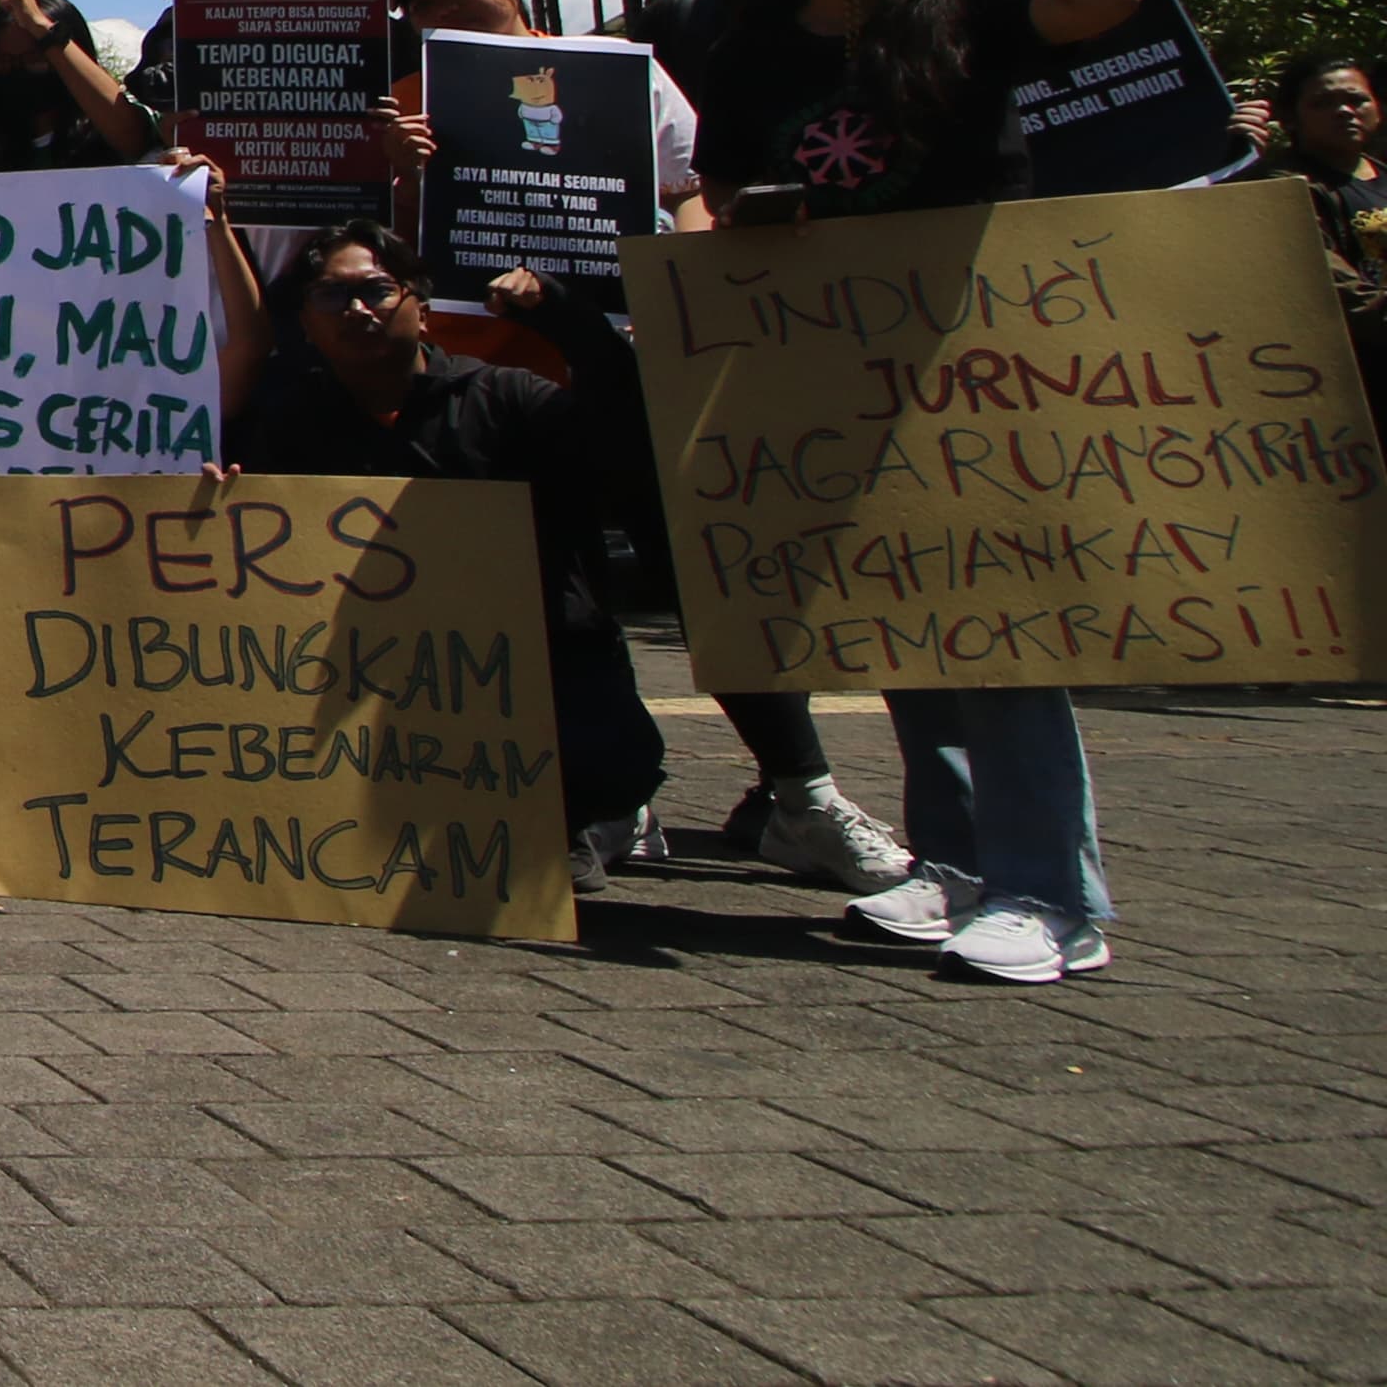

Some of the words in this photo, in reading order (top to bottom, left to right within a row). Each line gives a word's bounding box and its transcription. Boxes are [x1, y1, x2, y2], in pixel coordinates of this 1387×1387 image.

[197, 44, 265, 64] TEMPO
[271, 44, 365, 66] DIGUGAT,
[221, 68, 344, 88] KEBENARAN
[1070, 39, 1181, 89] KEBEBASAN
[200, 91, 366, 112] DIPERTARUHKAN
[1047, 94, 1109, 128] GAGAL
[1108, 68, 1185, 109] DIMUAT
[453, 166, 487, 182] SAYA
[491, 169, 561, 187] HANYALAH
[564, 174, 625, 192] SEORANG
[561, 195, 597, 211] YANG
[31, 202, 184, 279] JADI
[449, 230, 507, 246] MELIHAT
[457, 209, 525, 227] MENANGIS
[529, 214, 563, 230] LUAR
[568, 216, 620, 236] DALAM,
[454, 251, 522, 268] TERHADAP
[527, 258, 569, 273] MEDIA
[574, 260, 620, 276] TEMPO
[56, 298, 208, 375] MAU
[37, 393, 215, 464] CERITA
[51, 493, 417, 602] PERS
[25, 610, 512, 718] DIBUNGKAM
[97, 710, 555, 798] KEBENARAN
[23, 792, 511, 902] TERANCAM
